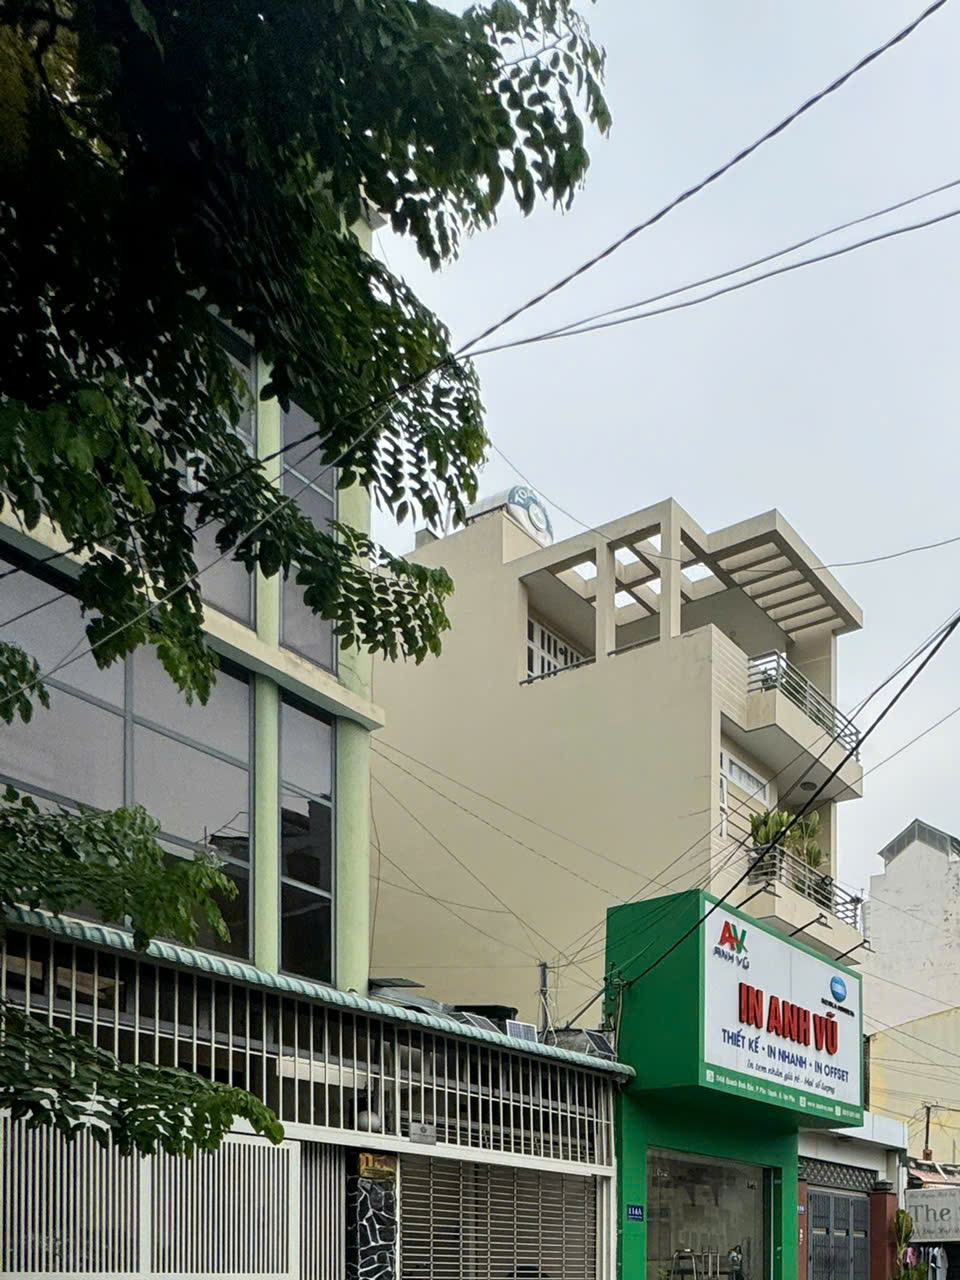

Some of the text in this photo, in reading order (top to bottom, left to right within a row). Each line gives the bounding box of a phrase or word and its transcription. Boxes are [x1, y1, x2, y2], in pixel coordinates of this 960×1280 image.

[738, 982, 838, 1056] IN ANH VŨ
[721, 1028, 849, 1083] THIẾT KẾ IN NHANH IN OFFSET
[908, 1204, 952, 1222] The
